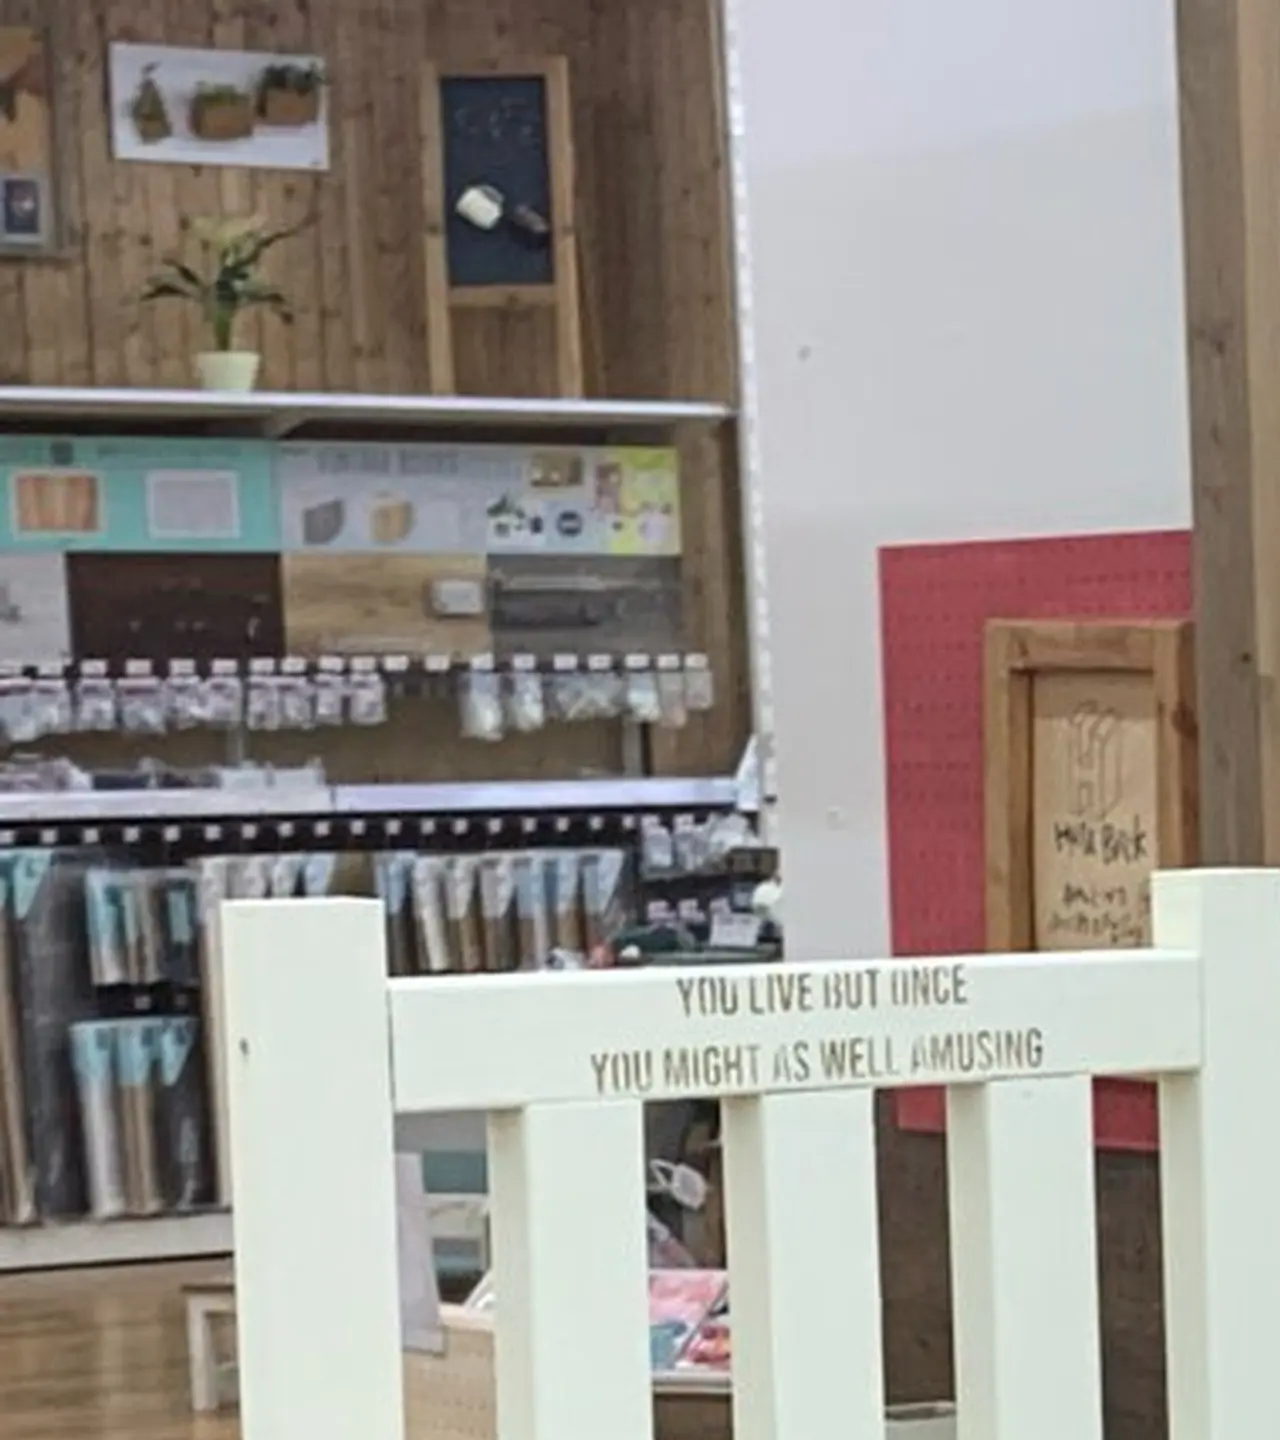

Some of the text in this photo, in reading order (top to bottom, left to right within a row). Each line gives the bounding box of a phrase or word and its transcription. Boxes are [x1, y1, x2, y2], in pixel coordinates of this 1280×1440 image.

[677, 964, 968, 1017] YOU LIVE BUT ONCE
[590, 1028, 1044, 1094] YOU MIGHT AS WELL AMUSING
